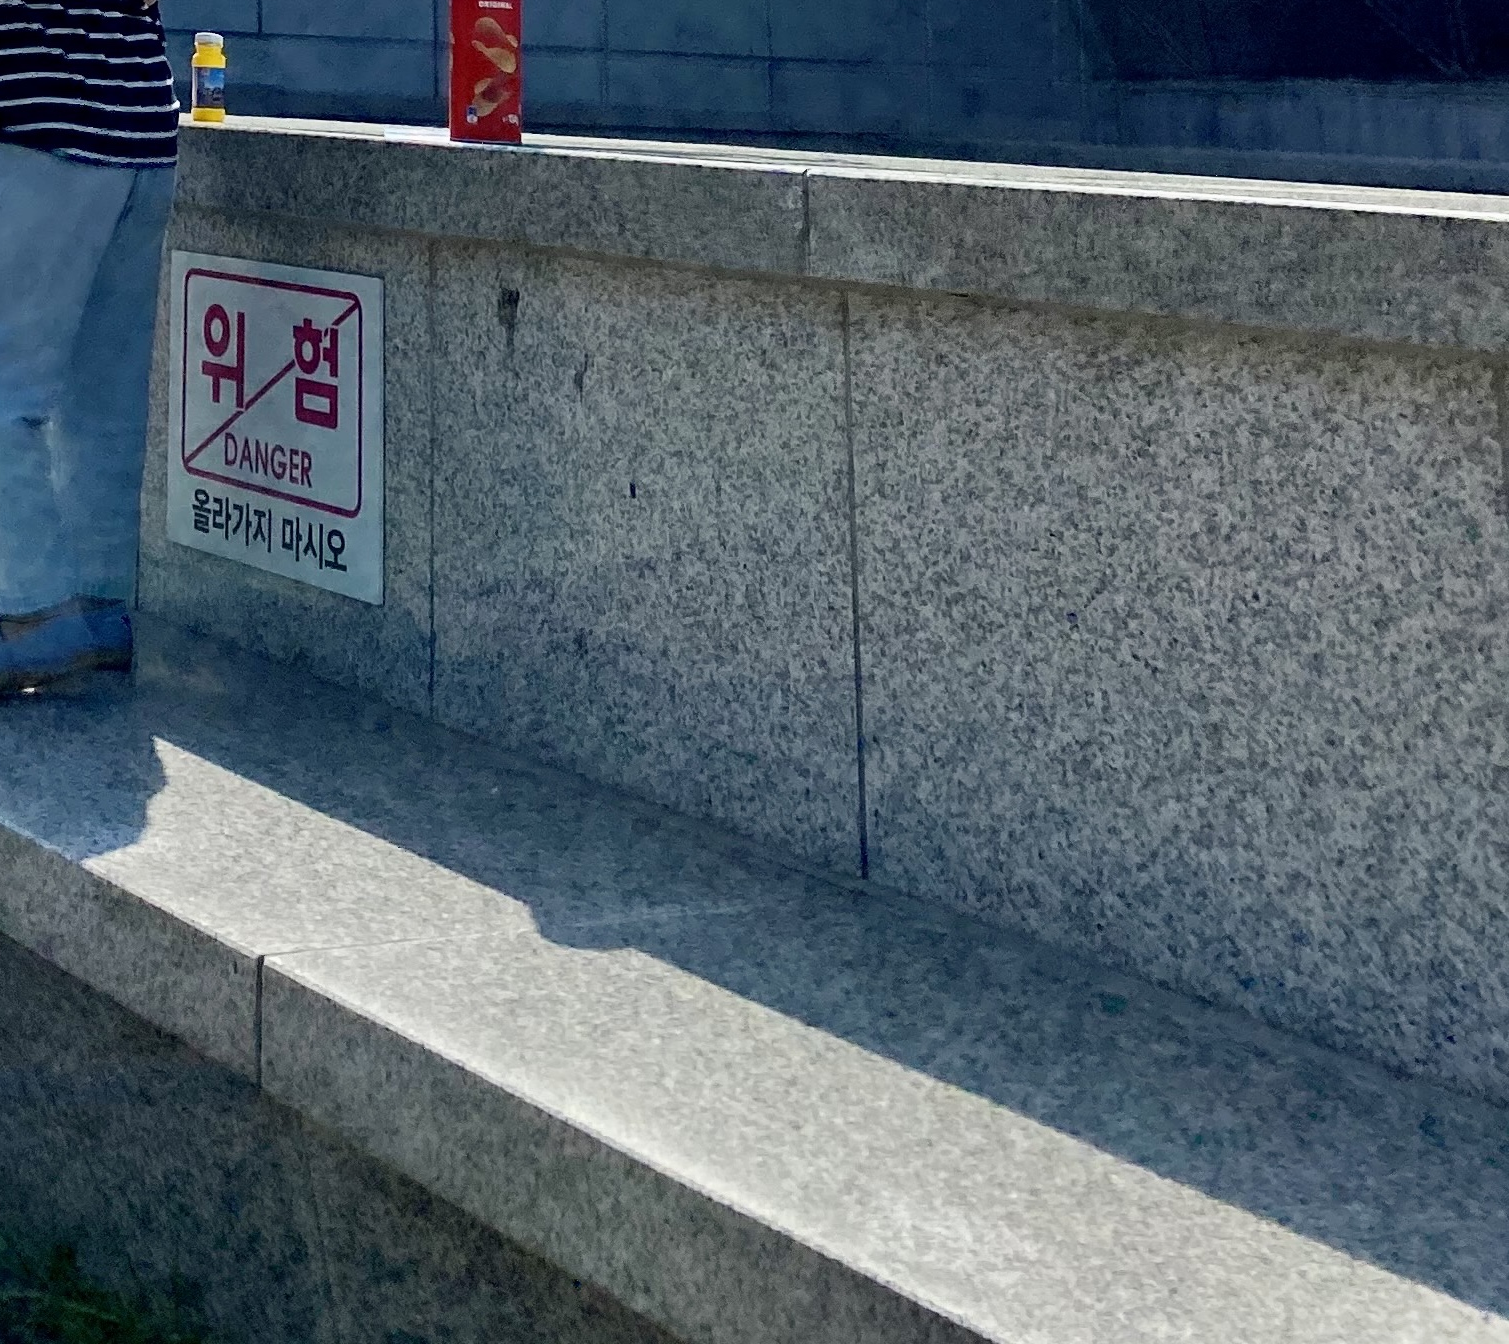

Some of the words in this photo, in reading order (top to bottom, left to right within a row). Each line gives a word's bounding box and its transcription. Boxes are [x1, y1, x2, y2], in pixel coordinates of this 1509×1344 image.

[202, 304, 338, 430] 위험
[225, 432, 312, 488] DANGER
[192, 489, 271, 553] 올라가지
[282, 516, 347, 572] 마시오
